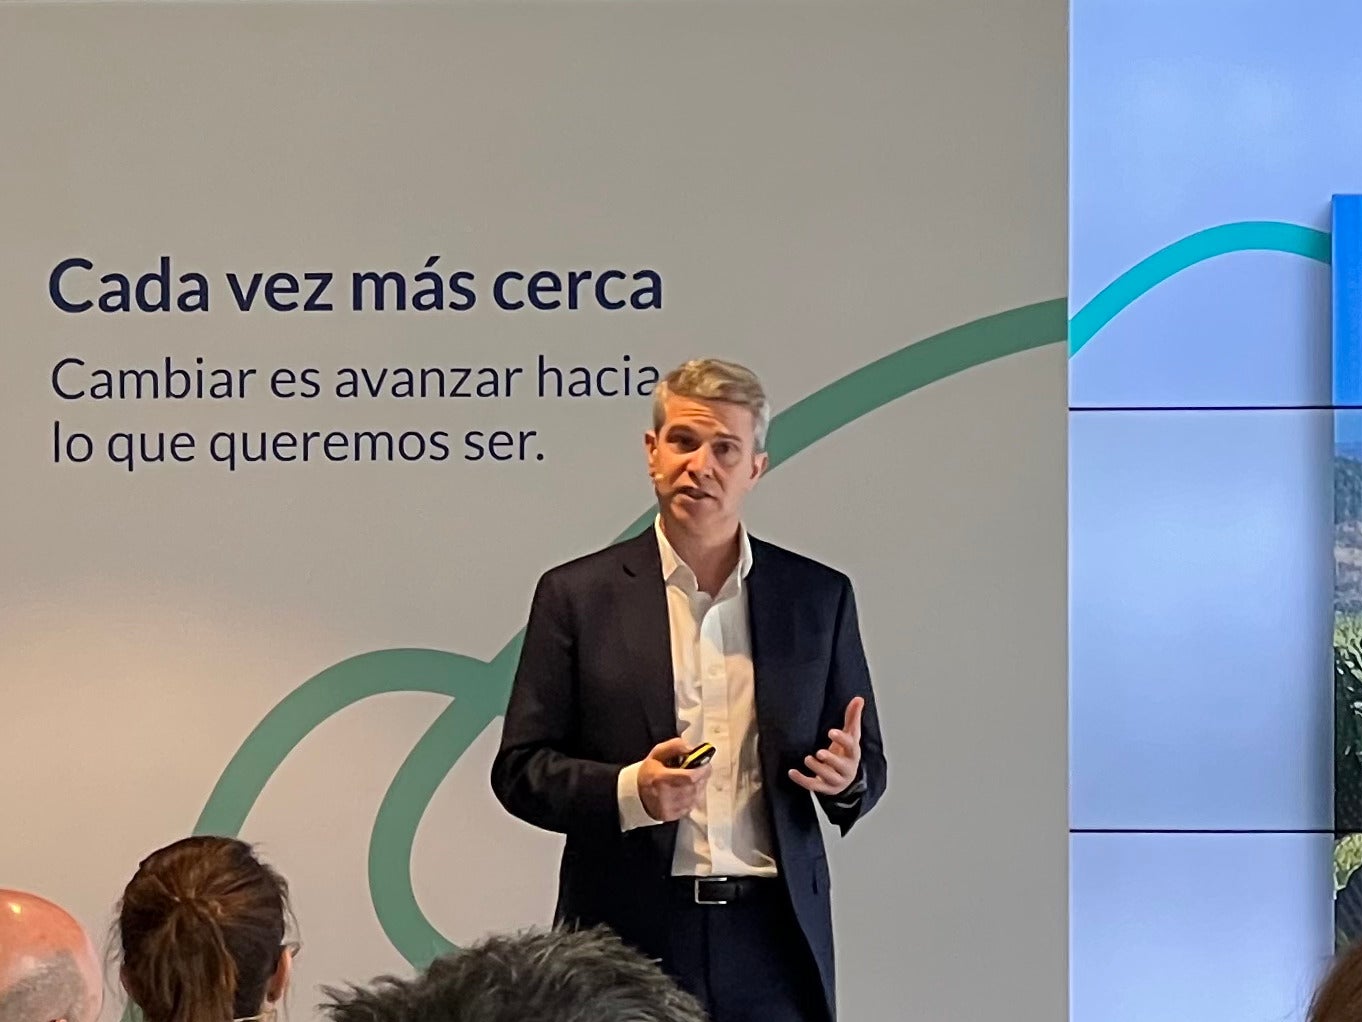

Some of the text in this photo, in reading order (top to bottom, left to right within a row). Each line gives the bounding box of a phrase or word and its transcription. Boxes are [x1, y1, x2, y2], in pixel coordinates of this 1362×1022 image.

[48, 256, 663, 313] Cada vez más cerca
[51, 355, 660, 400] Cambiar es avanzar hacia
[53, 421, 544, 472] lo que queremos ser.
